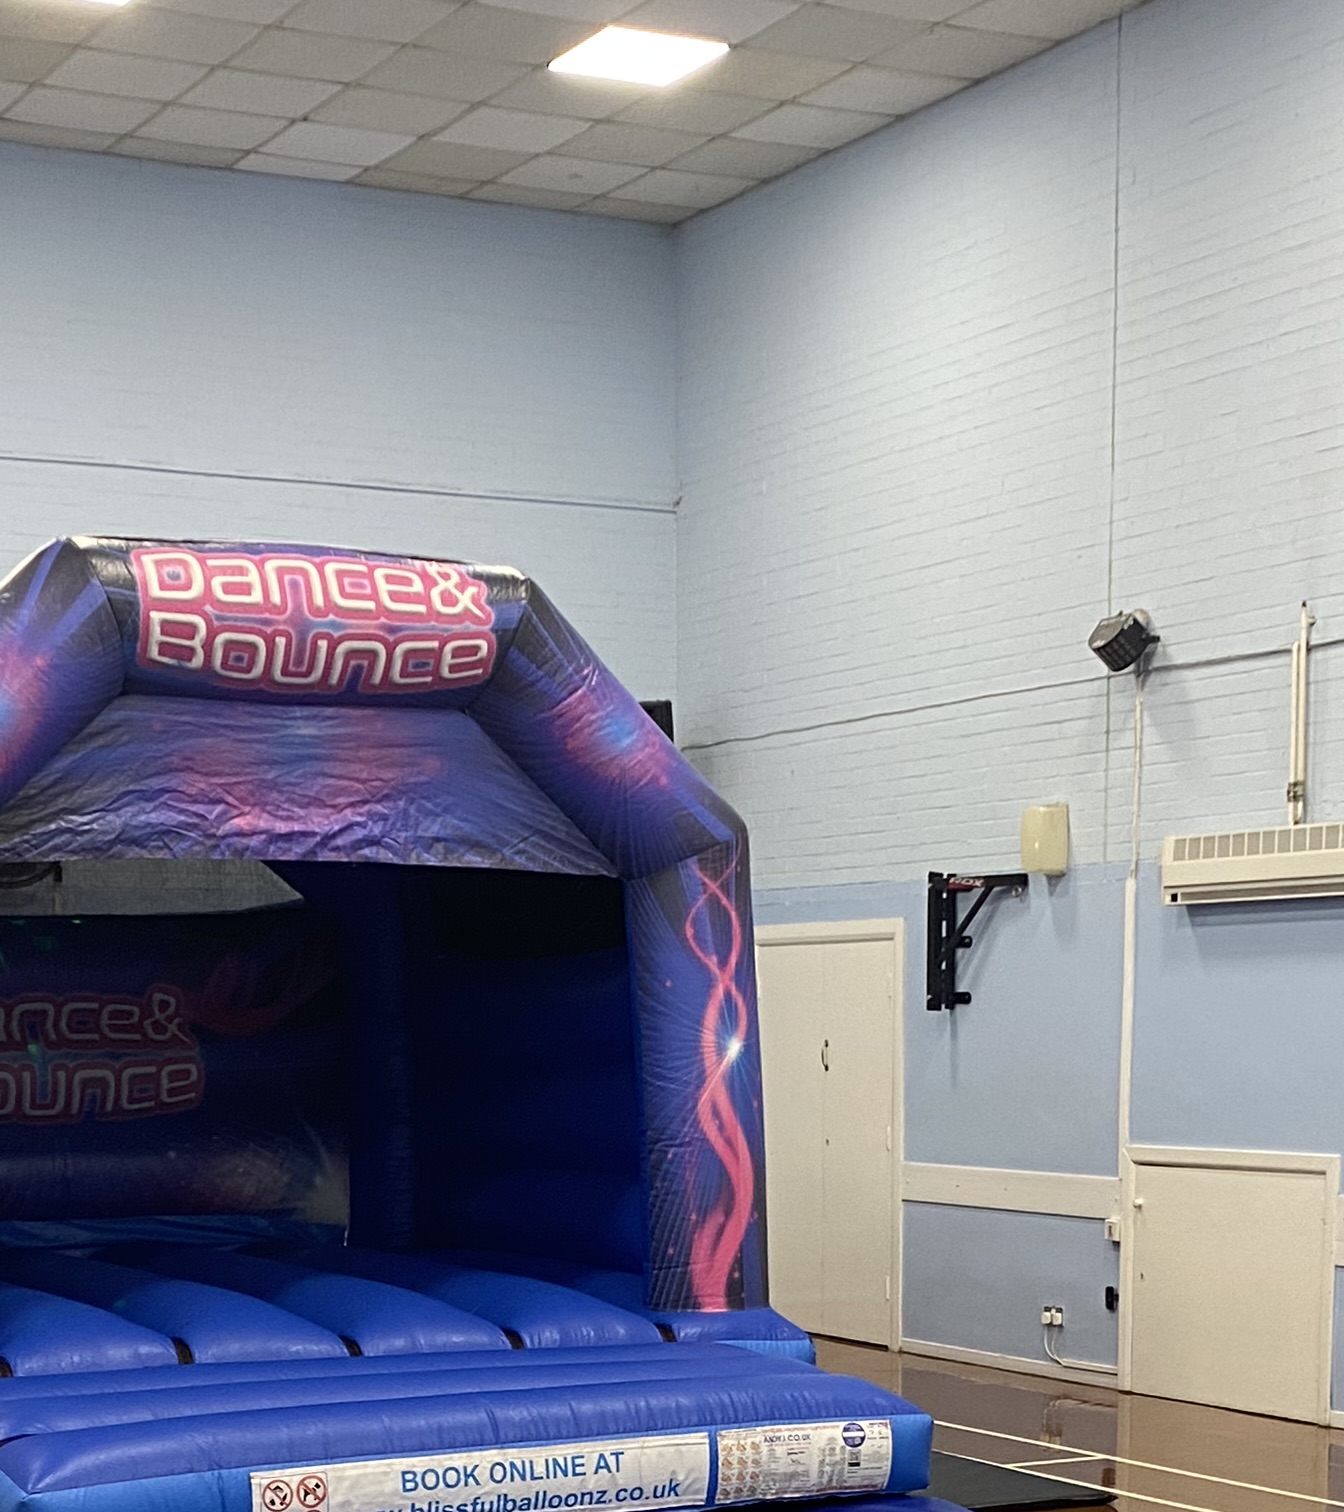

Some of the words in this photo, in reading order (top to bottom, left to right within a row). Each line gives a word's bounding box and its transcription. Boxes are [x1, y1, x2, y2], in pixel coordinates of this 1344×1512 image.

[147, 610, 489, 685] Bounce
[401, 1464, 480, 1493] BOOK
[489, 1454, 587, 1485] ONLINE
[593, 1451, 625, 1475] AT
